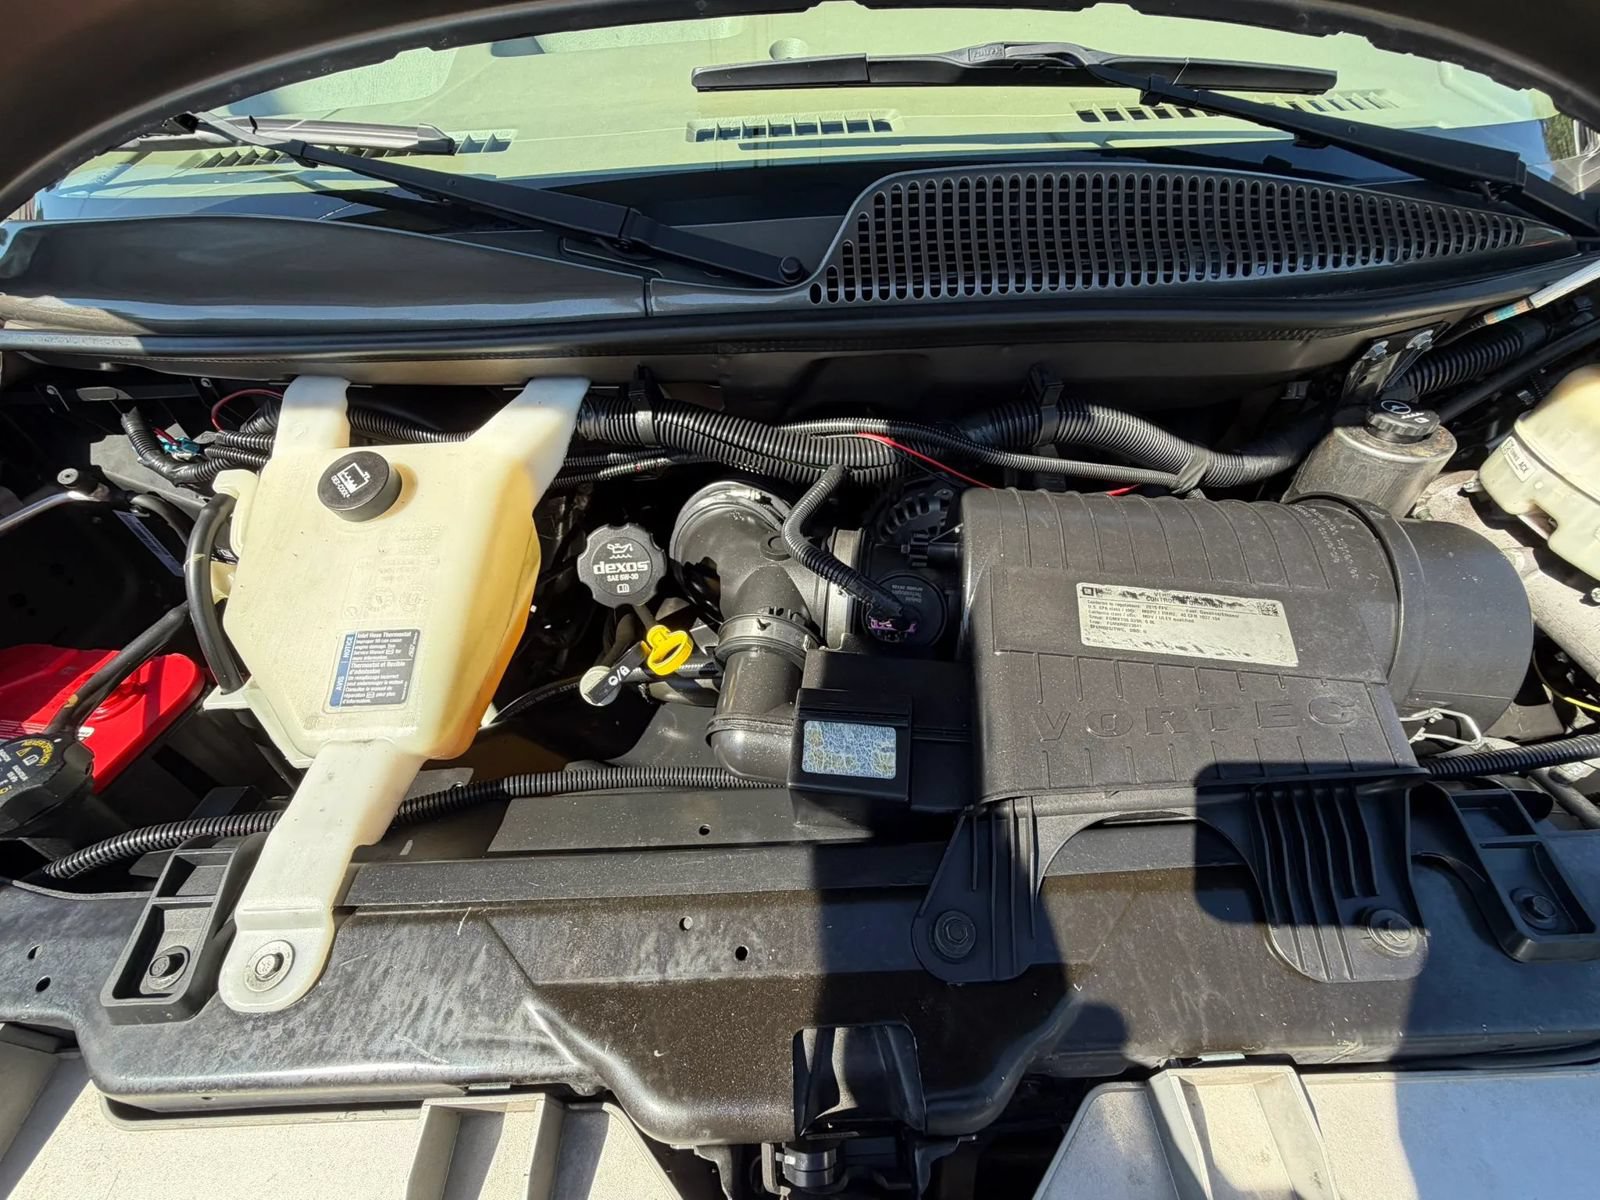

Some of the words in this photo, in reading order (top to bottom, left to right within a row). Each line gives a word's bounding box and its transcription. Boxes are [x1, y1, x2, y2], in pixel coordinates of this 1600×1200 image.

[593, 560, 650, 574] dexos
[343, 636, 353, 658] NOTICE
[336, 676, 344, 690] AVIS
[1031, 696, 1362, 741] VORTEC
